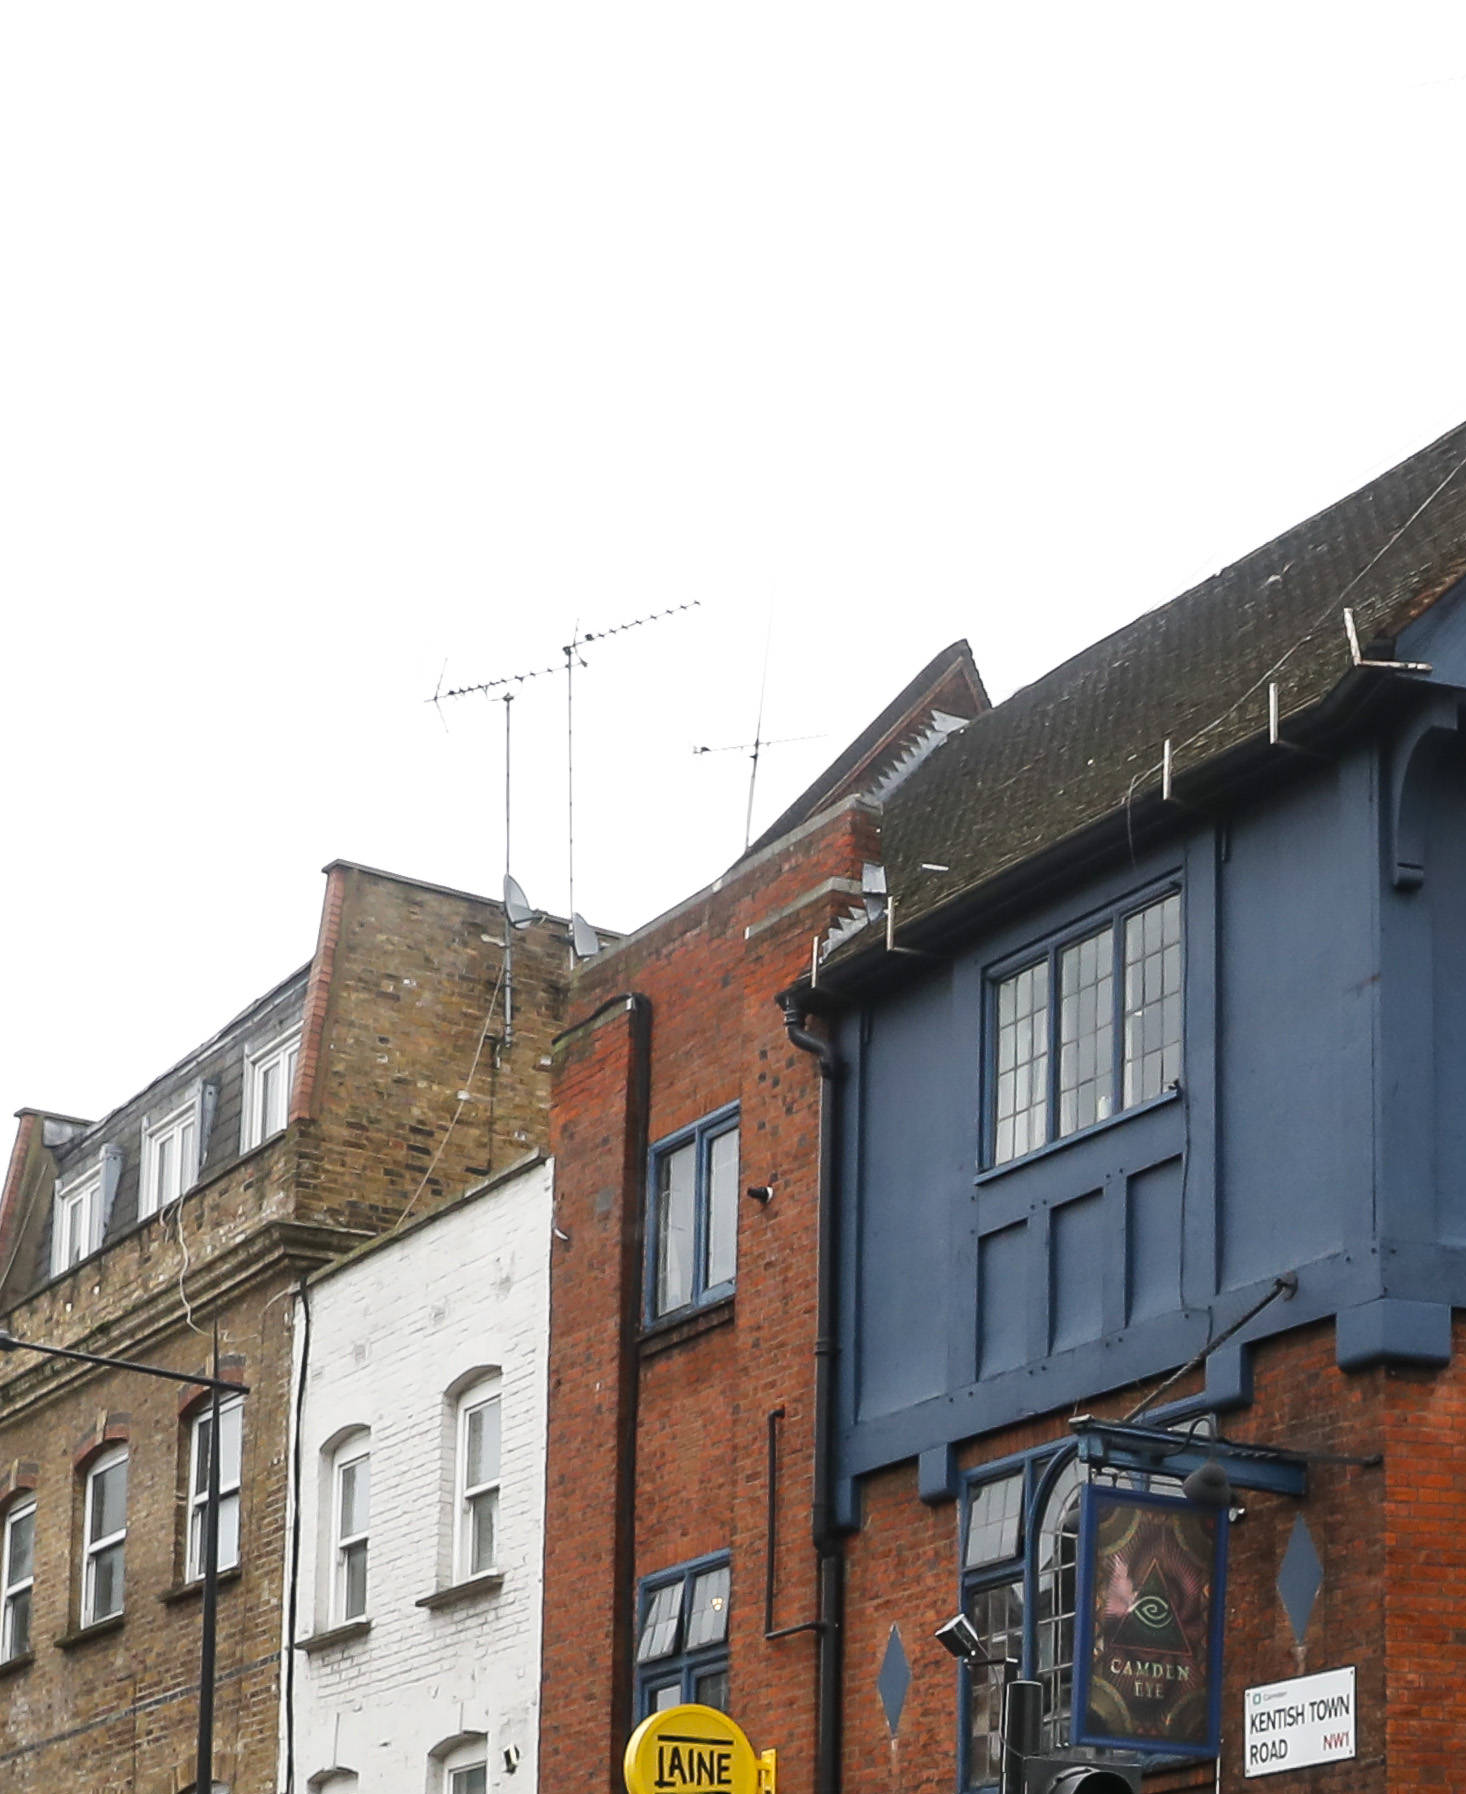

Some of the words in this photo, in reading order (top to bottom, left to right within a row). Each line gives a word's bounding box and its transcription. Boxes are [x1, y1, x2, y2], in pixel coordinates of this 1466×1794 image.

[1110, 1658, 1190, 1681] CAMDEN
[1250, 1703, 1305, 1735] KENTISH
[1309, 1693, 1350, 1723] TOWN
[654, 1745, 732, 1788] LAINE
[1250, 1739, 1288, 1766] ROAD
[1323, 1731, 1350, 1751] NW1
